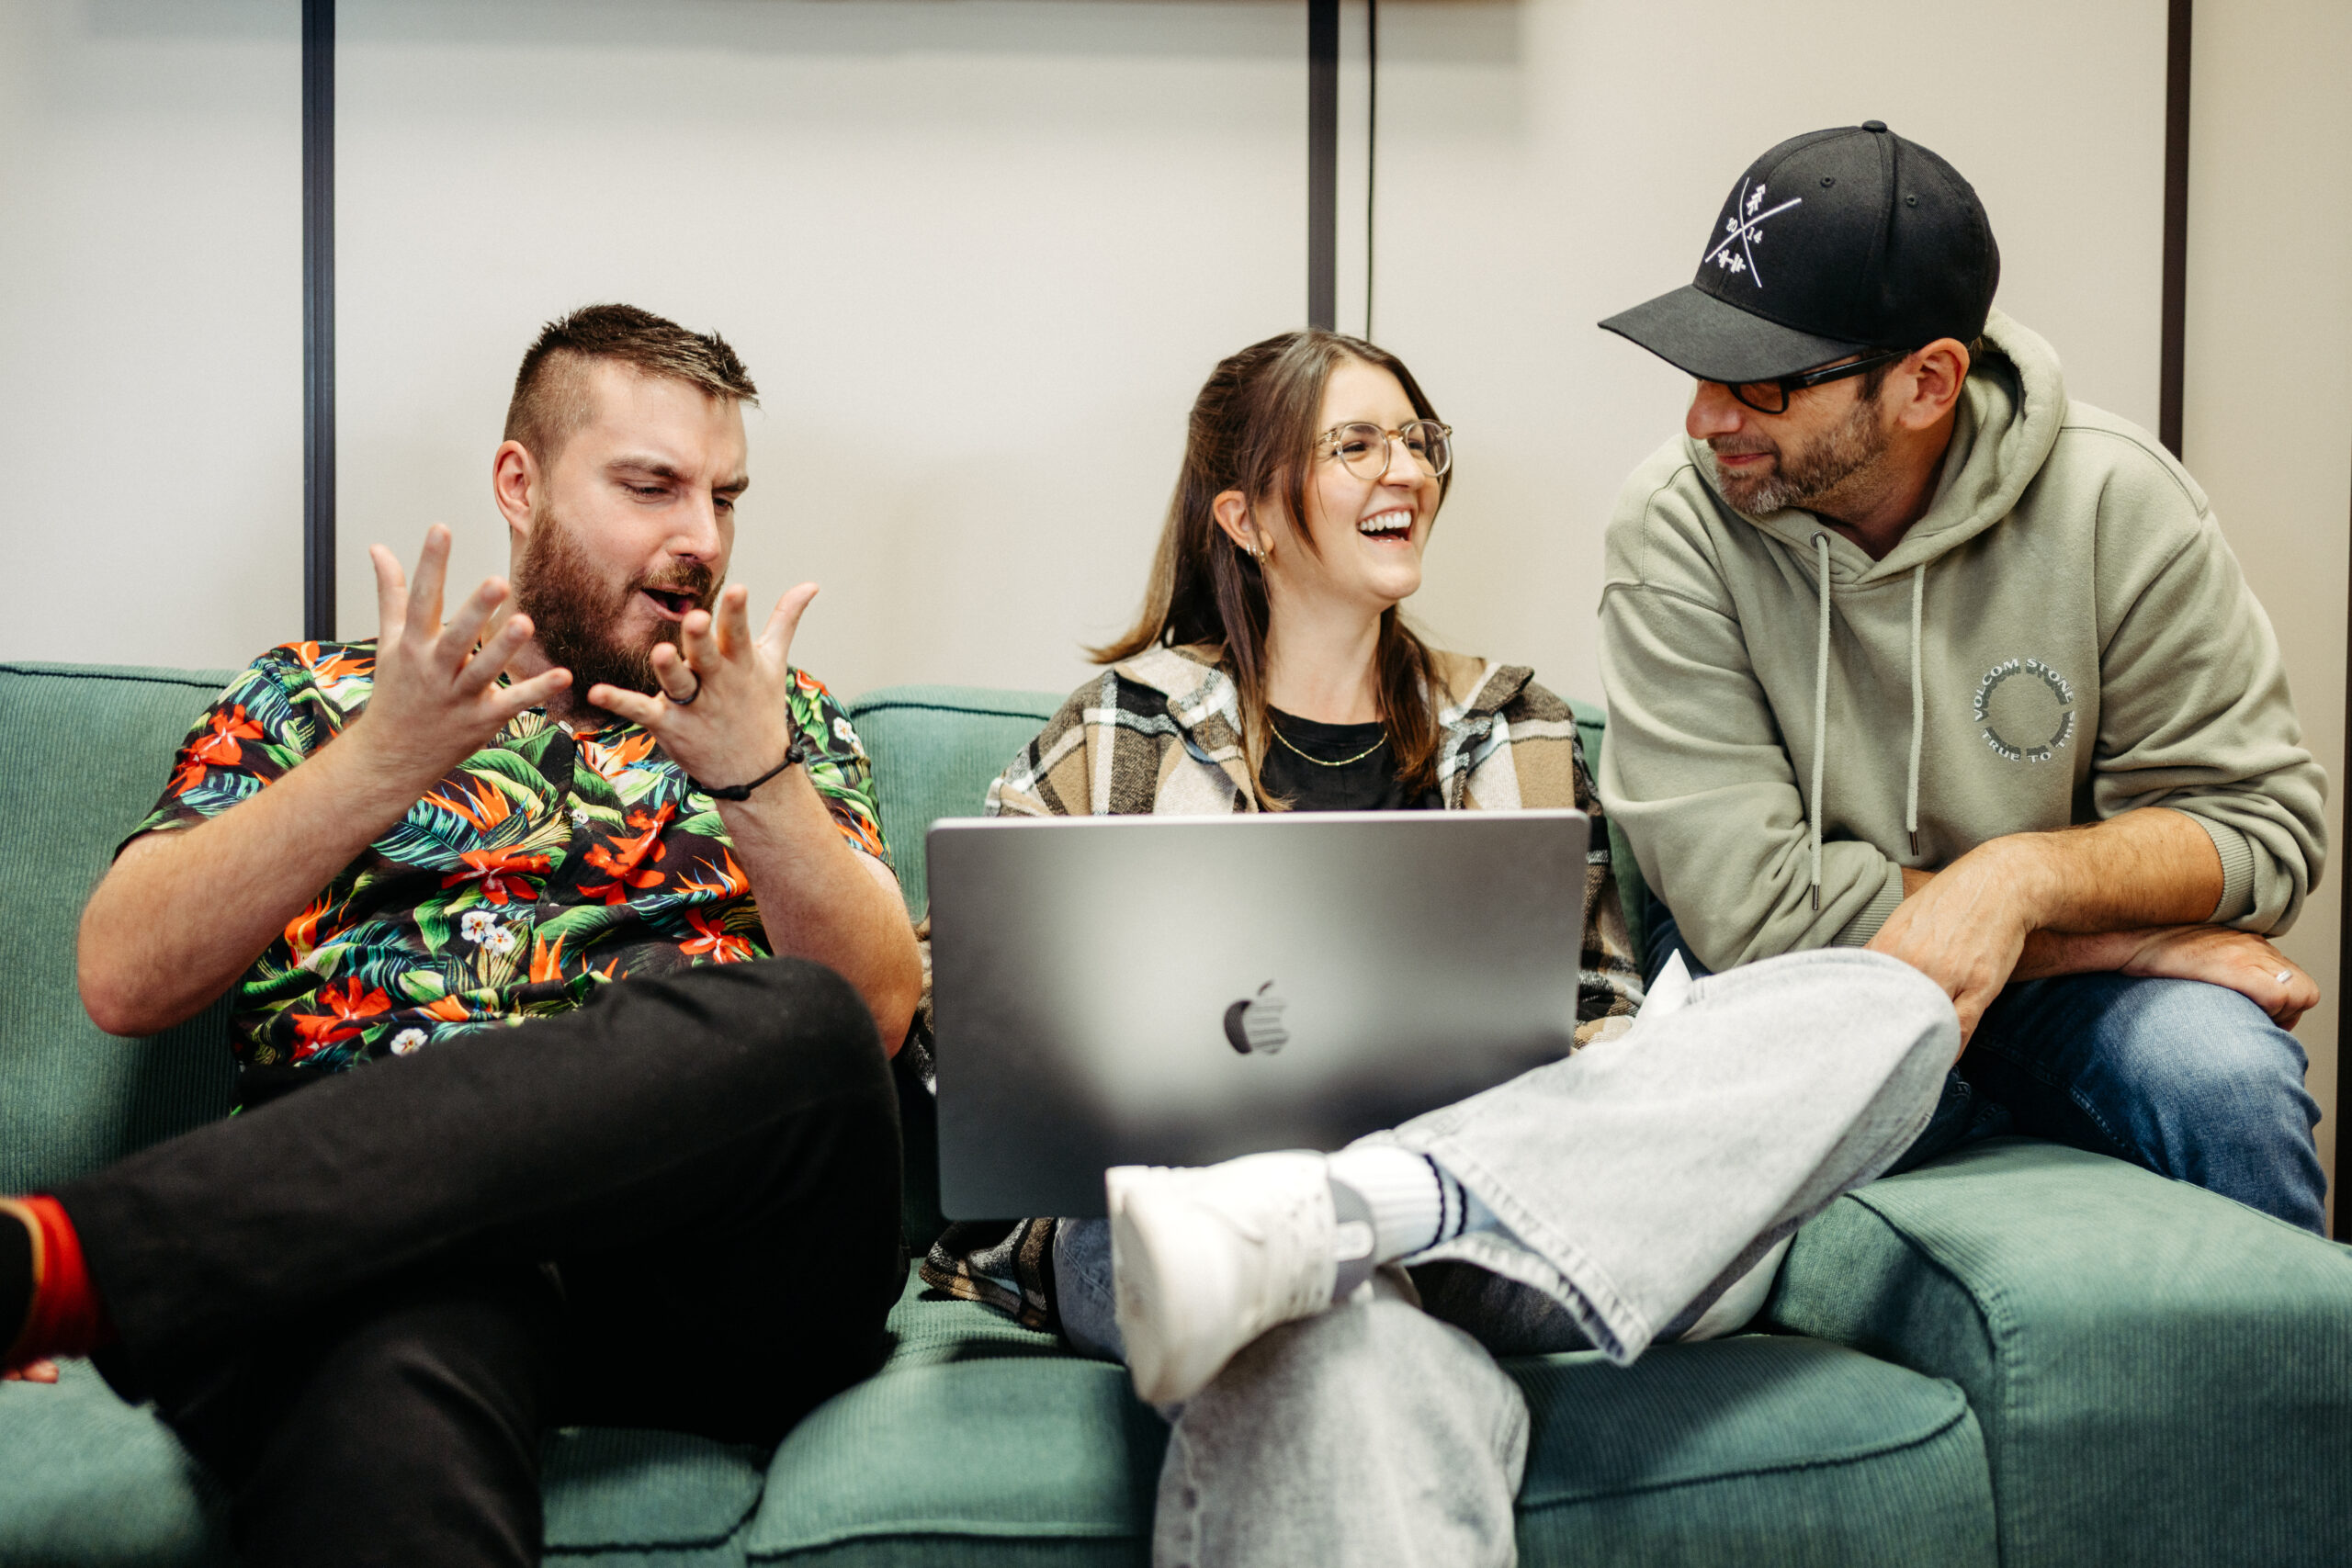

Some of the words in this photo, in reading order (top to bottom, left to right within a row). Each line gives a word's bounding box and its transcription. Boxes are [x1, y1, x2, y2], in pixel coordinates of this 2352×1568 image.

[1725, 217, 1738, 232] 20
[1747, 227, 1763, 243] 14
[1973, 659, 2019, 722] VOLCOM
[2026, 658, 2074, 704] STONE
[1981, 728, 2020, 762] TRUE
[2027, 750, 2052, 763] TO
[2053, 711, 2075, 750] THIS
